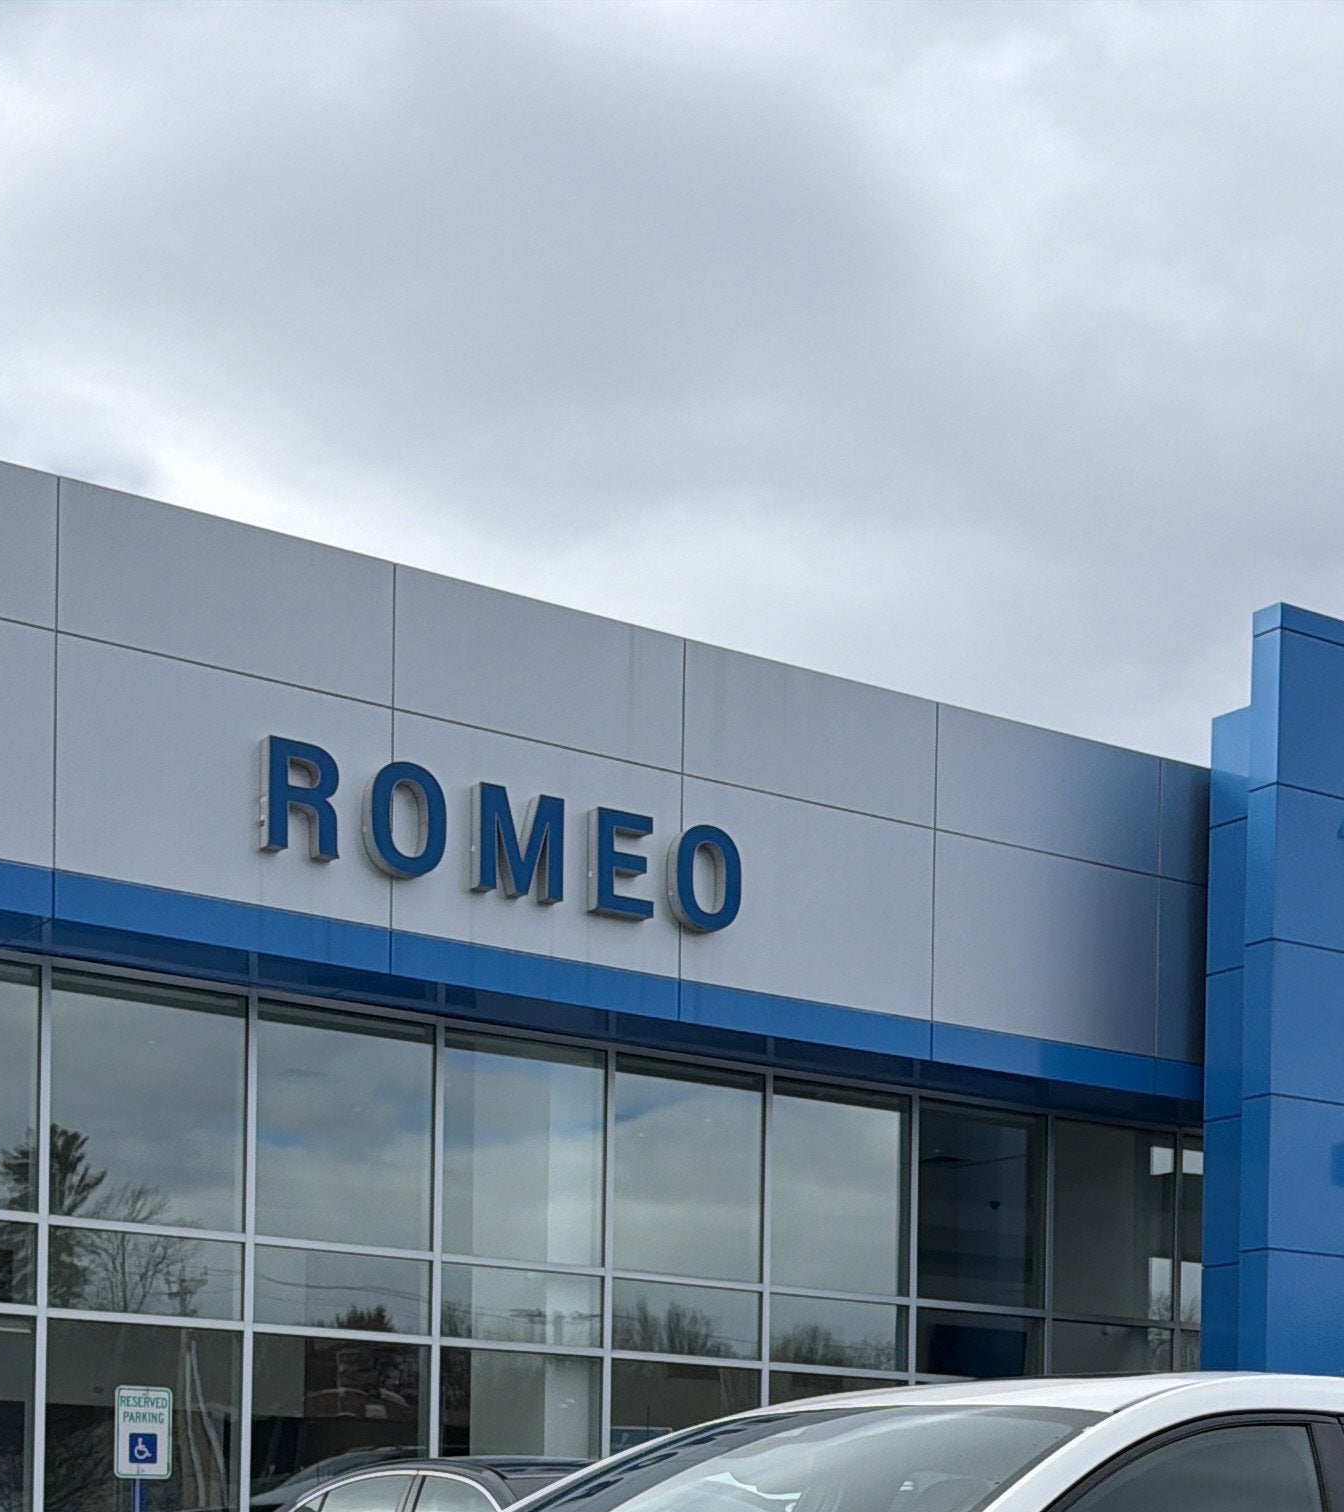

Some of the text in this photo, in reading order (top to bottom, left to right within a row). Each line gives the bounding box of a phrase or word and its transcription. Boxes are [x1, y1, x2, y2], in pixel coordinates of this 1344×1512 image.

[259, 735, 742, 933] ROMEO
[119, 1395, 168, 1409] RESERVED
[122, 1410, 165, 1425] PARKING
